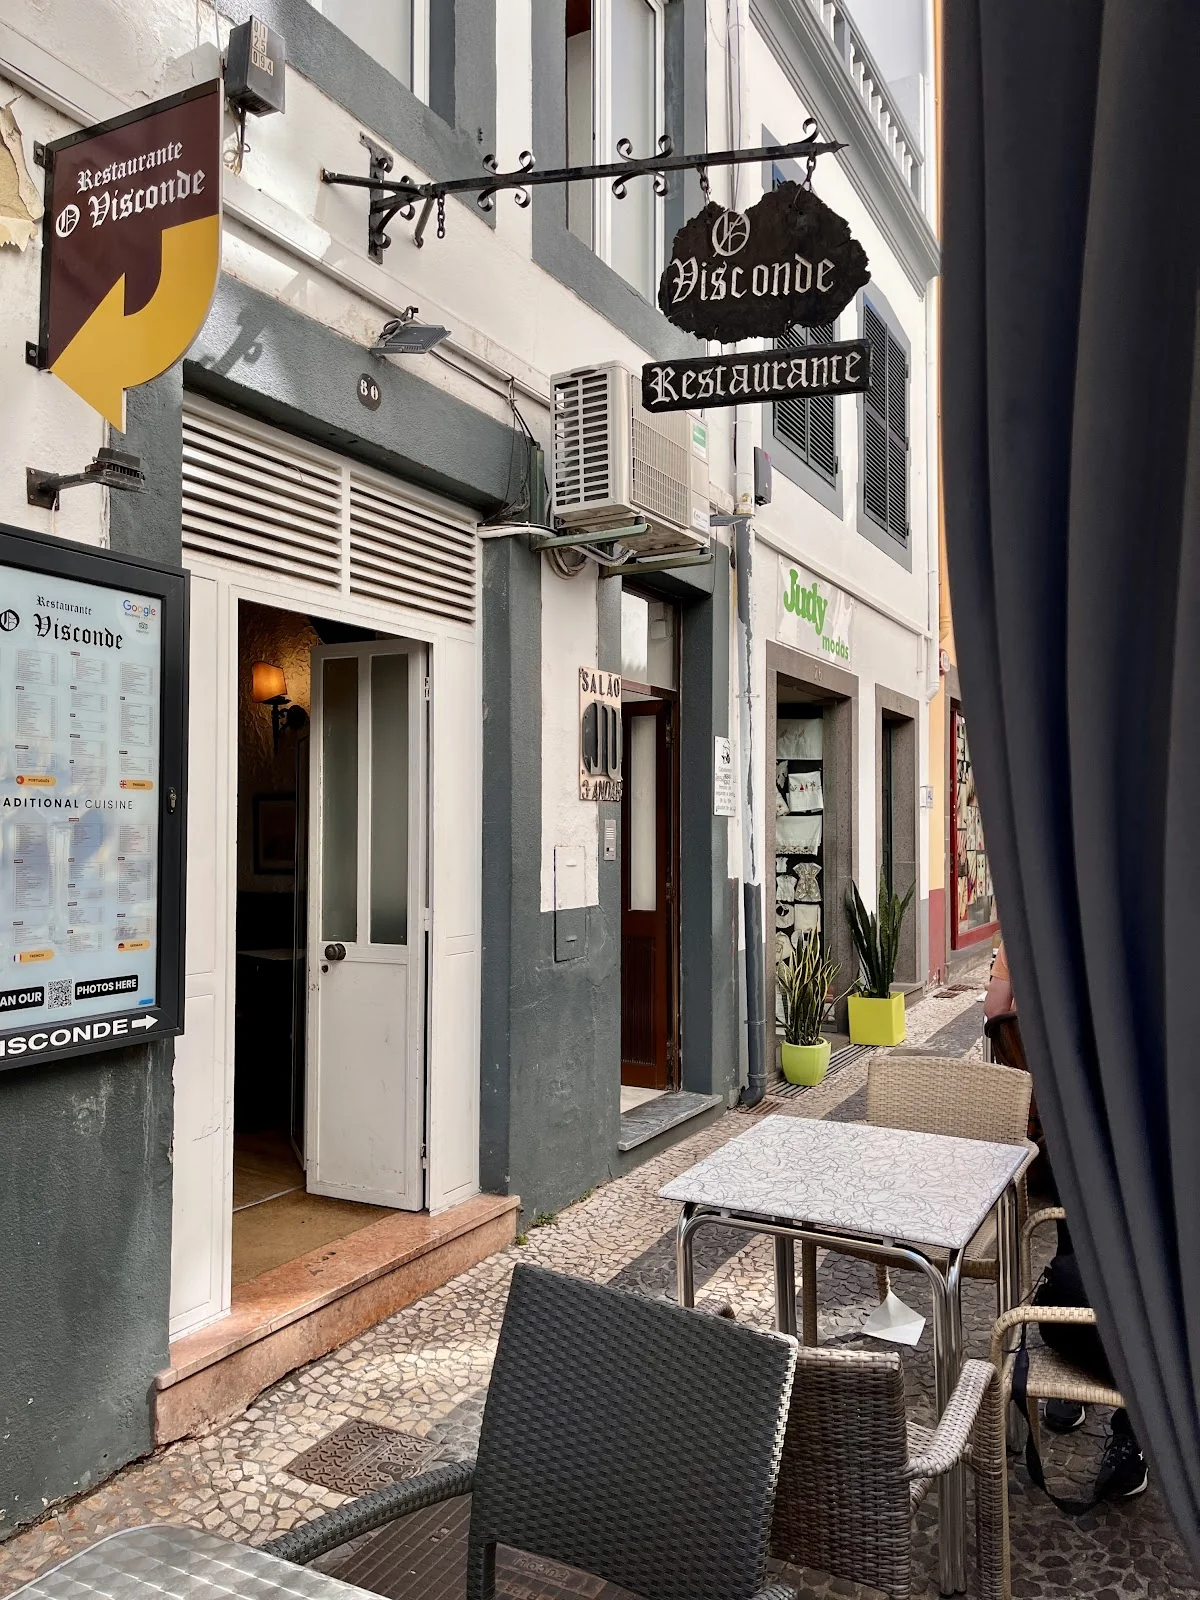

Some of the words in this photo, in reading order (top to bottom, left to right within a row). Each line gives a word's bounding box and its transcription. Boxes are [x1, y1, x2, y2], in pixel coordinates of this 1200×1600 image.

[254, 35, 266, 54] 25
[253, 50, 273, 74] 094
[76, 141, 183, 194] Restaurante
[55, 204, 81, 238] O
[88, 169, 206, 228] Visconde
[711, 209, 751, 258] O
[671, 253, 836, 304] Visconde
[360, 379, 379, 401] 80
[650, 350, 863, 405] Restaurante
[36, 595, 93, 616] Restaurante
[123, 599, 156, 617] Google
[783, 568, 828, 636] Judy
[0, 609, 20, 632] O
[33, 613, 124, 650] Visconde
[822, 634, 849, 660] modas
[581, 671, 620, 698] SALÃO
[3, 797, 79, 809] ADITIONAL
[85, 799, 133, 810] CUISINE
[18, 991, 42, 1004] OUR
[76, 982, 114, 996] PHOTOS
[115, 978, 137, 991] HERE
